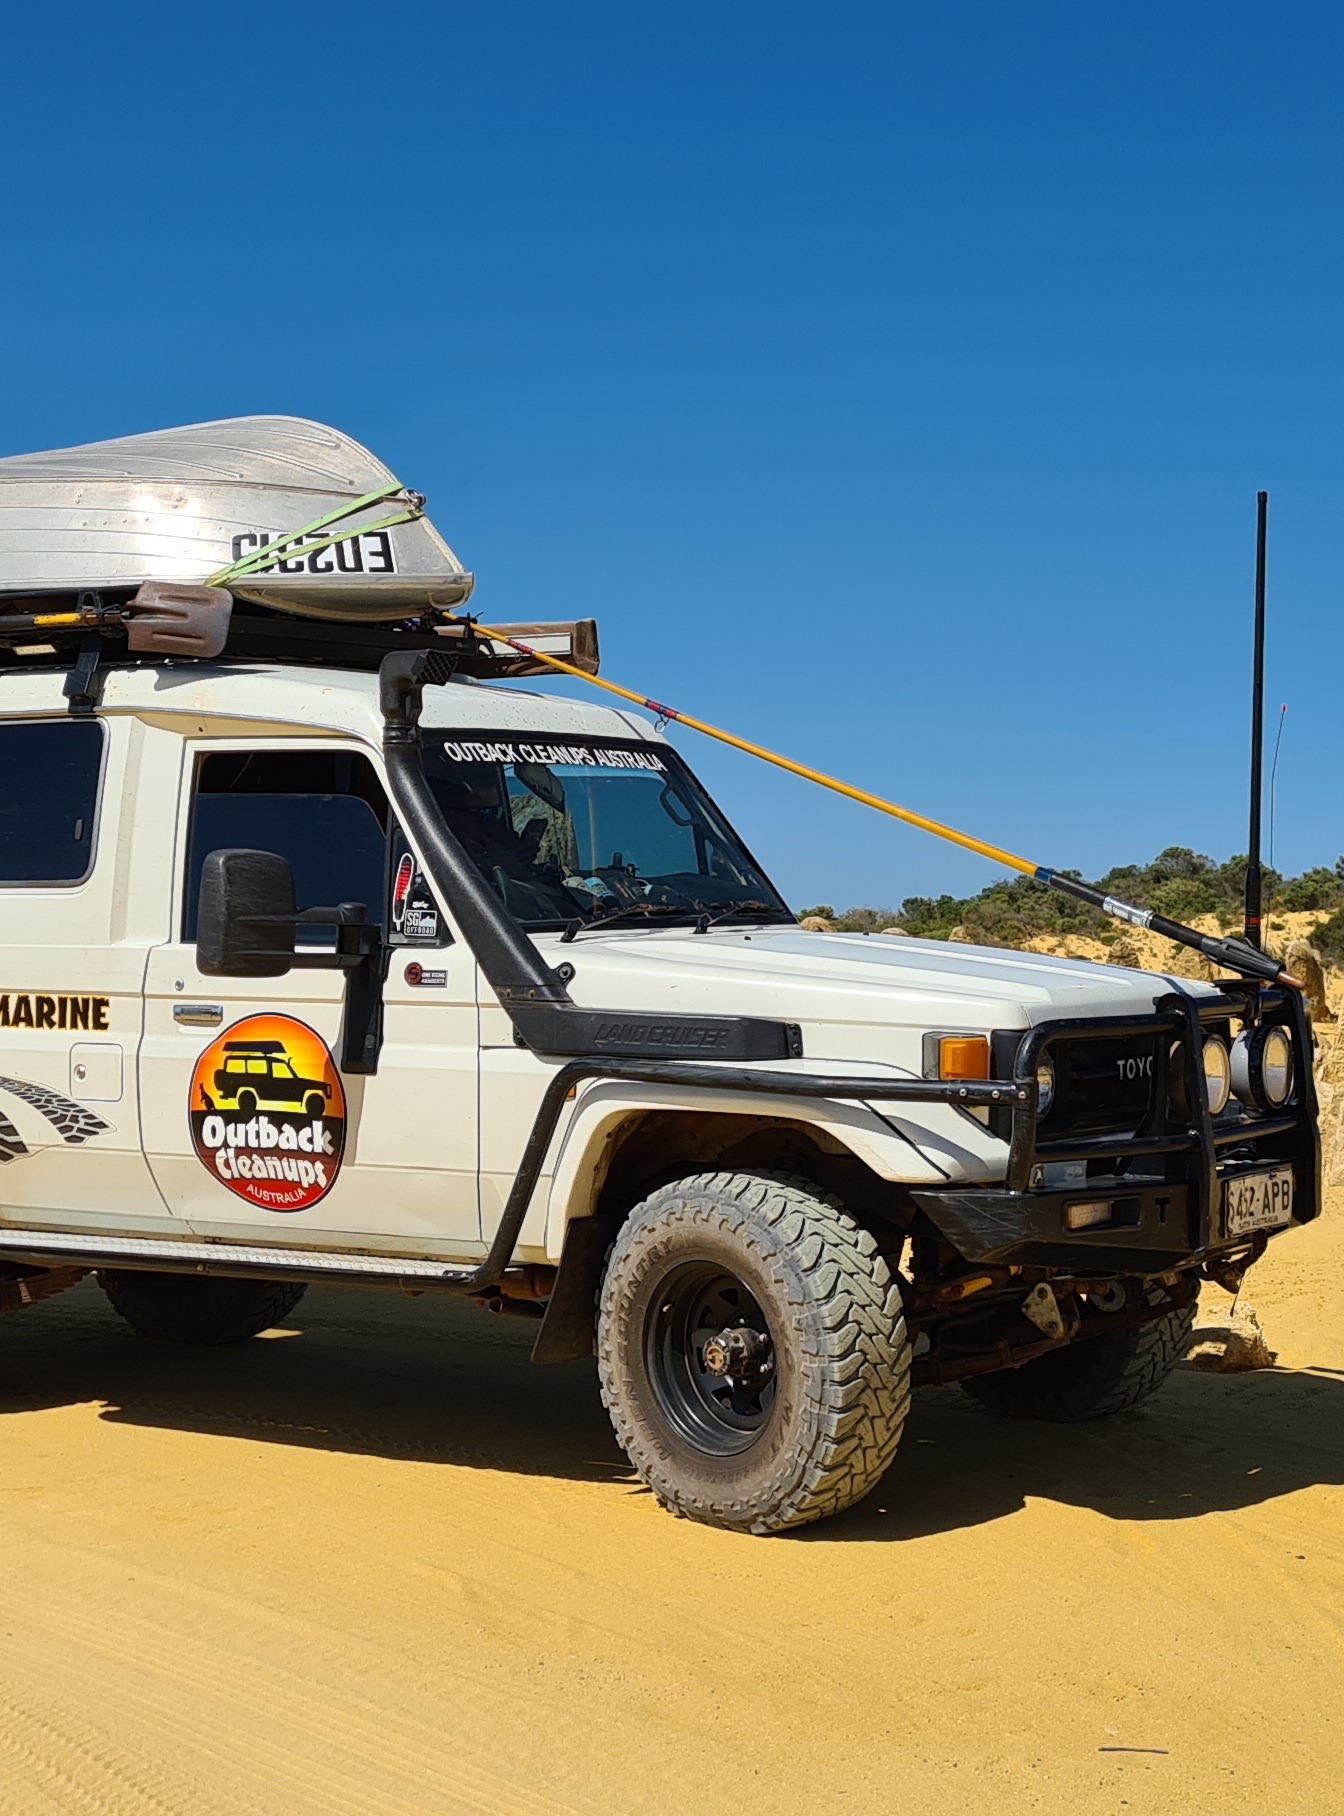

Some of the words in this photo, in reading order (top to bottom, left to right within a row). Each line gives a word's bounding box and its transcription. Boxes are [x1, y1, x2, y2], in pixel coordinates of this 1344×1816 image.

[444, 742, 523, 763] OUTBACK
[518, 744, 597, 767] CLEANUPS
[592, 749, 668, 772] AUSTRALIA
[406, 912, 420, 926] SG
[1116, 1055, 1154, 1081] TOYO
[202, 1115, 335, 1155] Outback
[215, 1148, 327, 1188] Cleanups
[246, 1183, 306, 1203] AUSTRALIA
